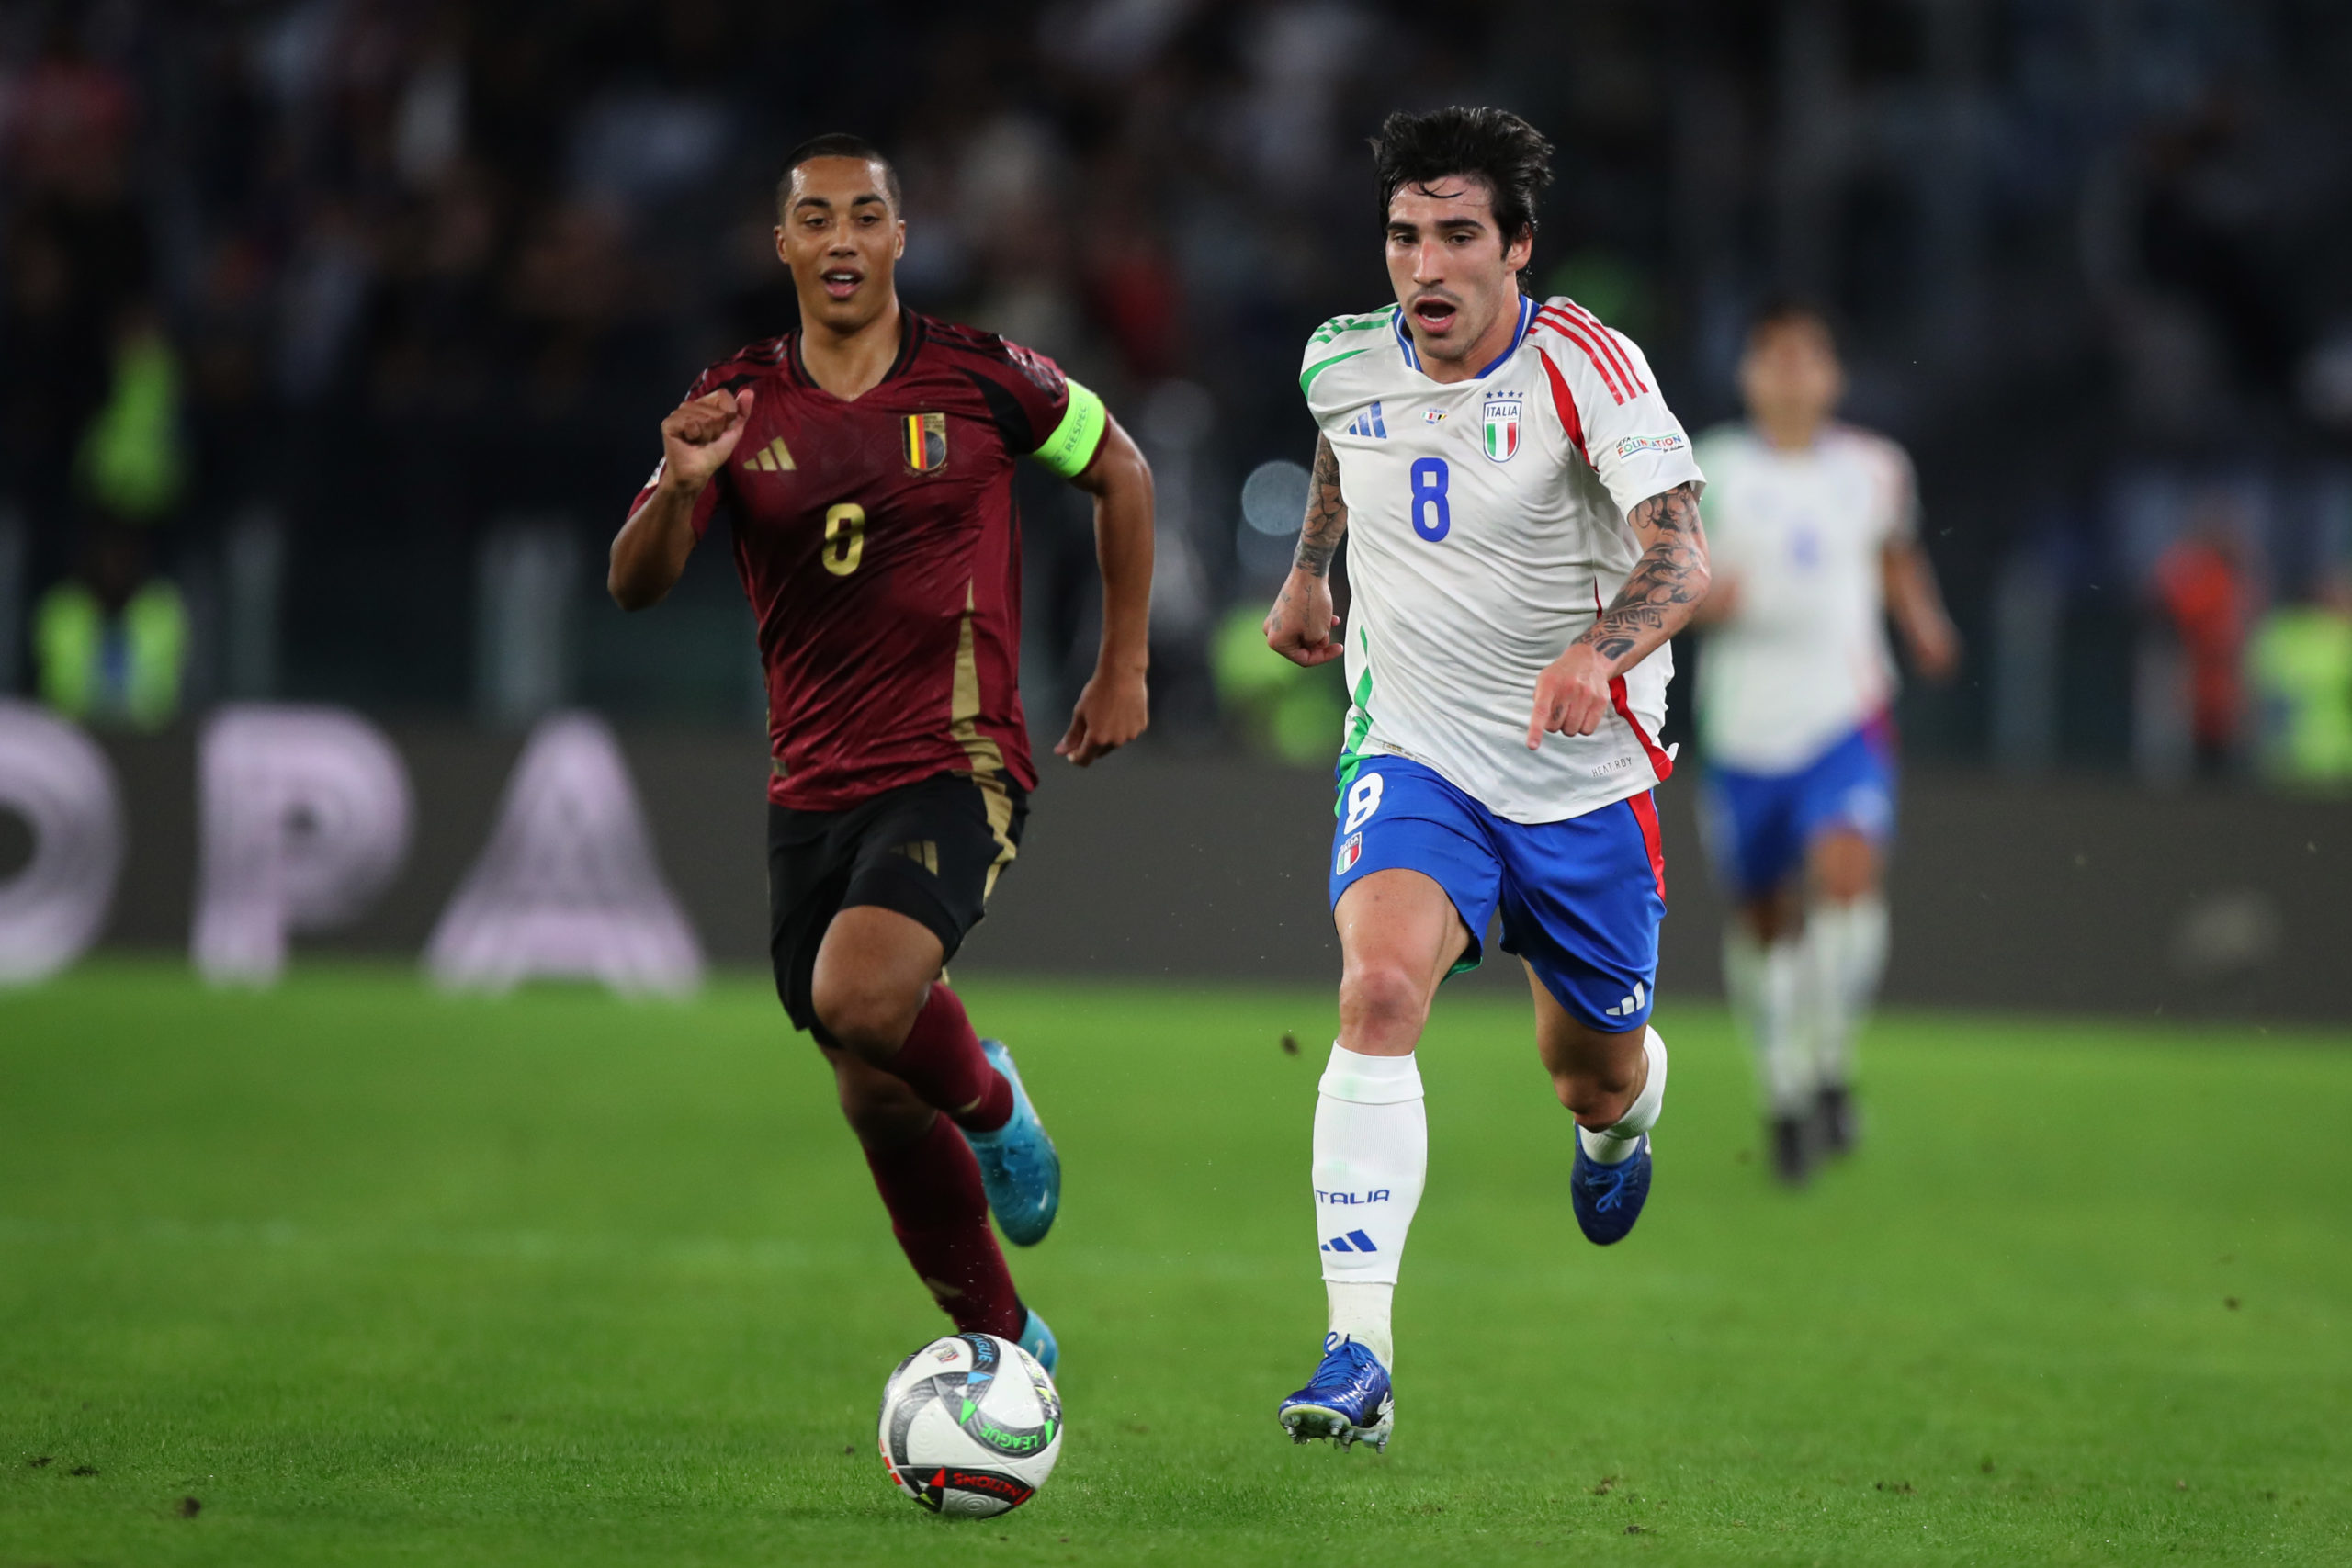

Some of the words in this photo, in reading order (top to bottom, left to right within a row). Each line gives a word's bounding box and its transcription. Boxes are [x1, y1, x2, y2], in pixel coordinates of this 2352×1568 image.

[1065, 398, 1087, 452] RESPEC
[1487, 405, 1518, 418] ITALIA
[1410, 457, 1451, 542] 8
[1343, 772, 1384, 835] 8
[978, 1423, 1039, 1450] LEAGUE
[953, 1472, 1023, 1497] NATIONS
